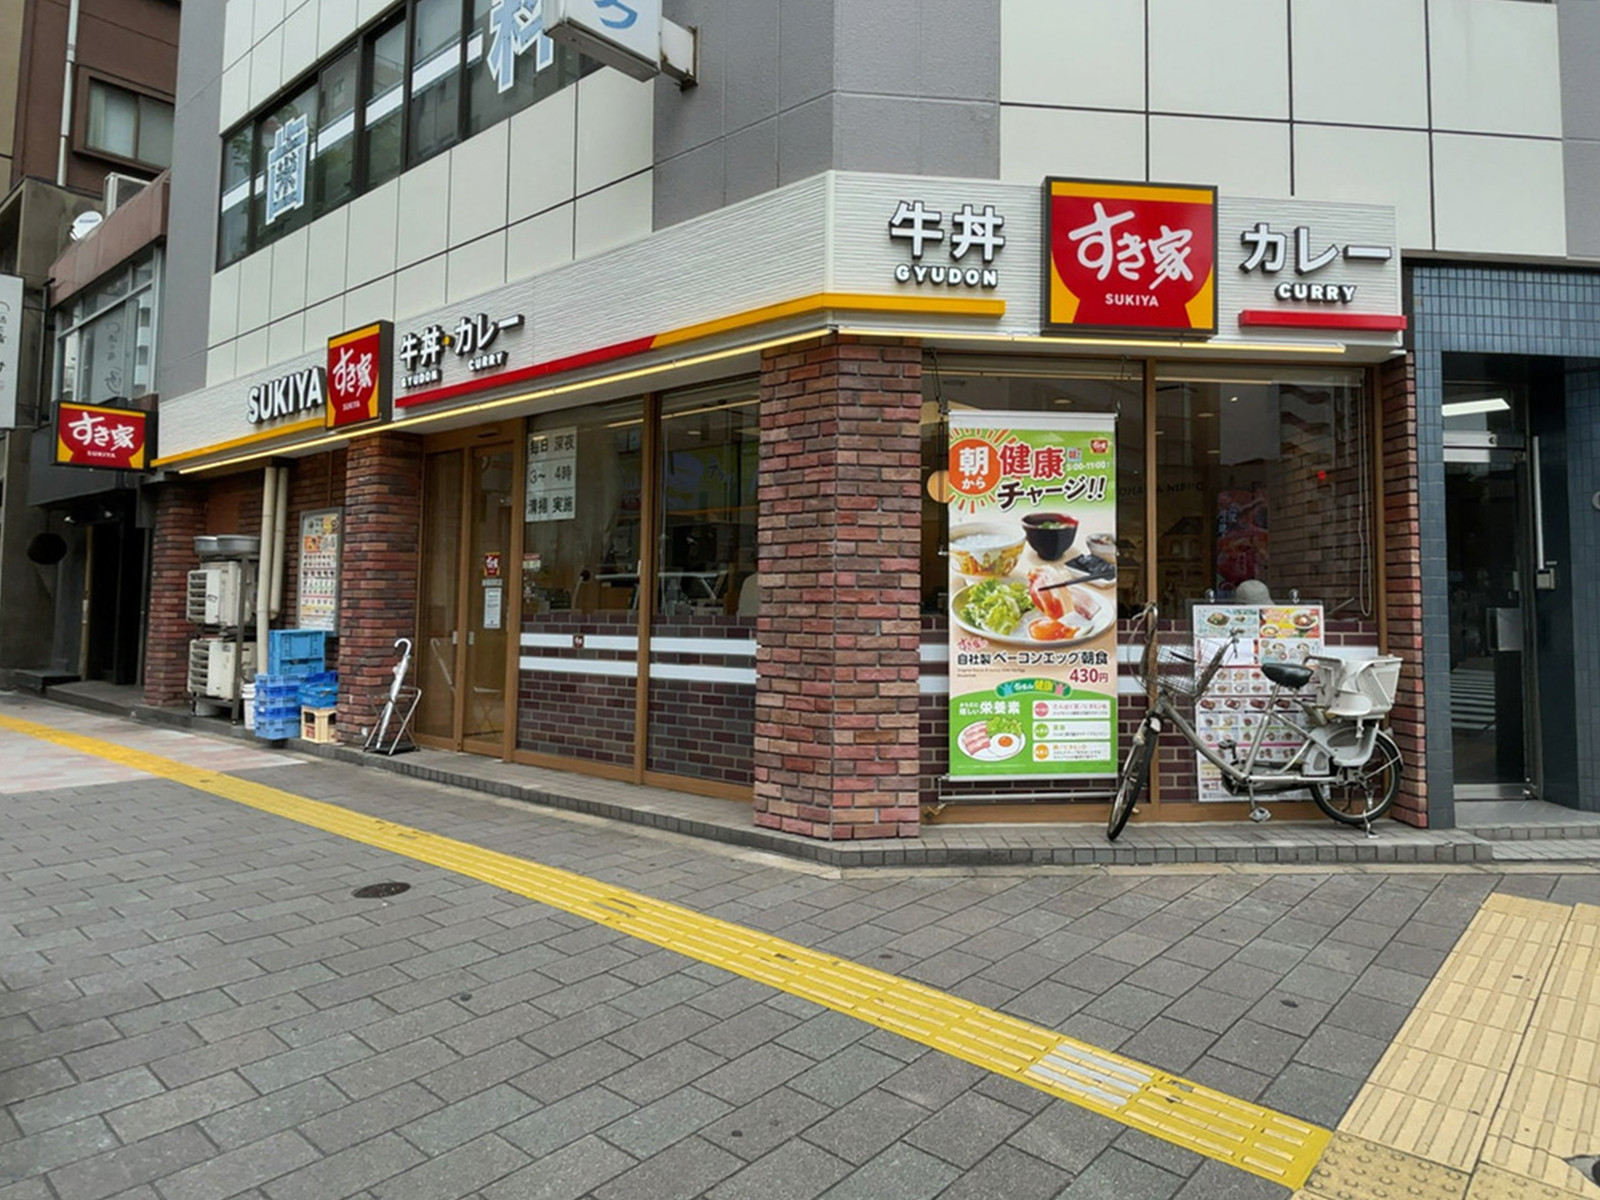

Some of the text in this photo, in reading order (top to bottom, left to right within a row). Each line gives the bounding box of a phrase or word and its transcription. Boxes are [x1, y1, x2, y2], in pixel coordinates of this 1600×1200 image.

[266, 113, 308, 225] 歯
[889, 200, 1005, 263] 牛丼
[1068, 201, 1194, 290] すき家
[1239, 222, 1393, 274] カレー
[894, 263, 999, 287] GYUDON
[1104, 293, 1160, 308] SUKIYA
[1275, 282, 1357, 304] CURRY
[332, 347, 373, 398] すき家
[467, 350, 508, 372] CURRY
[401, 367, 442, 390] GYUDON
[247, 365, 326, 424] SUKIYA
[68, 411, 135, 451] すき家
[87, 450, 116, 459] SUKIYA
[959, 446, 990, 476] 朝
[1000, 444, 1065, 479] 健康
[961, 478, 986, 490] から
[1069, 668, 1109, 684] 430円
